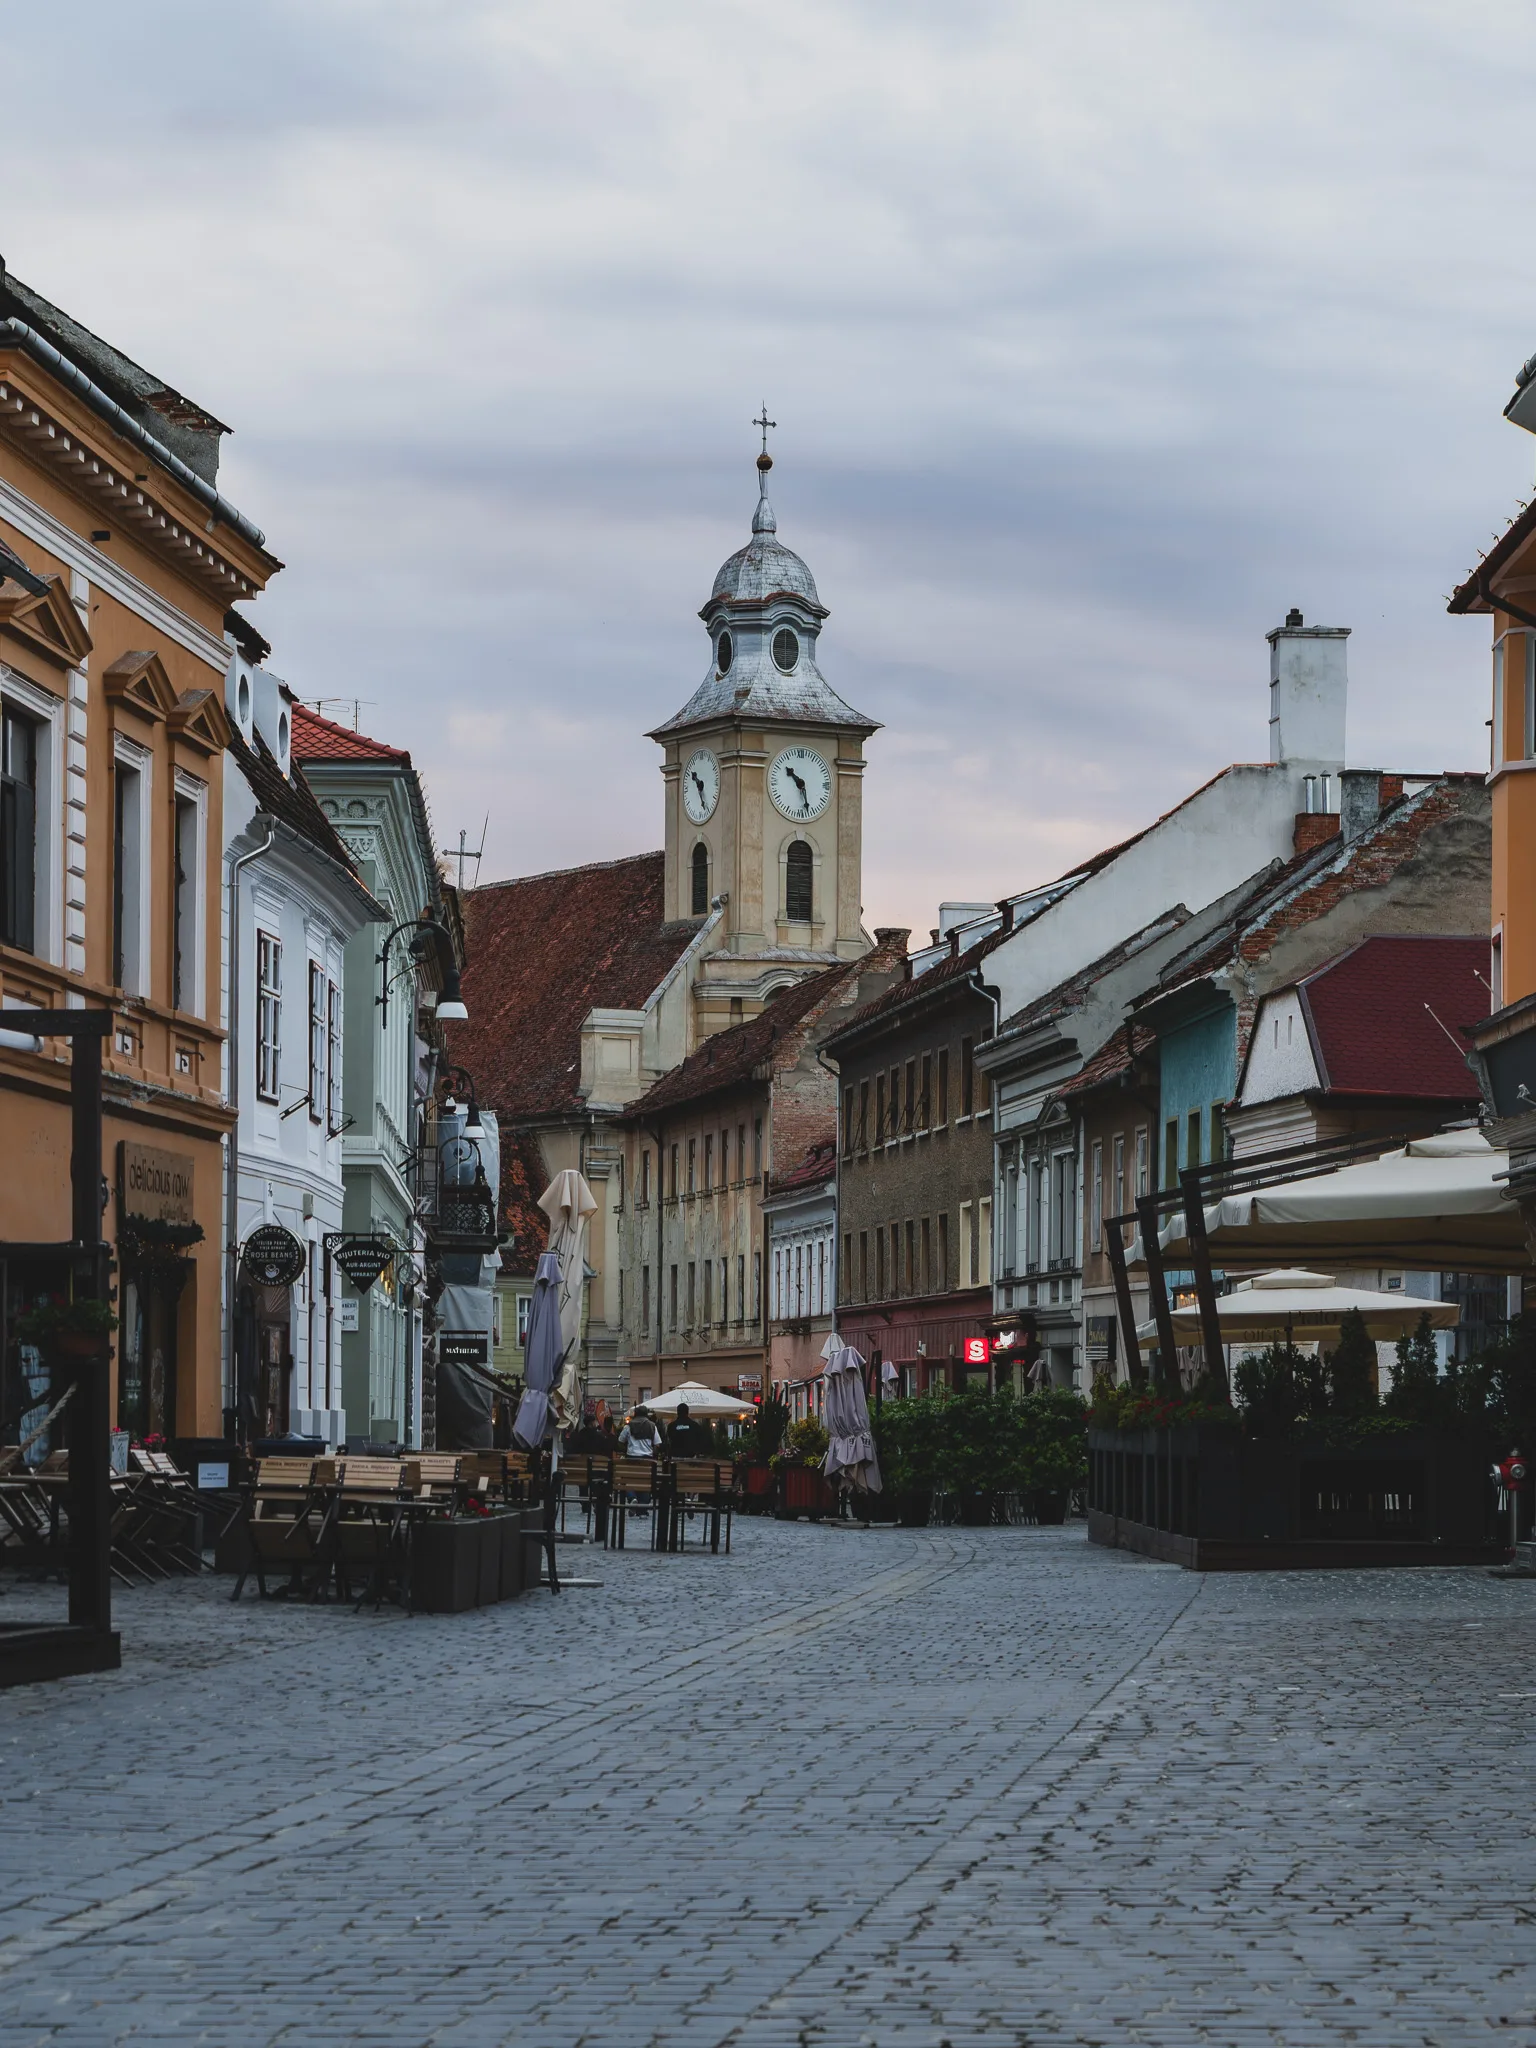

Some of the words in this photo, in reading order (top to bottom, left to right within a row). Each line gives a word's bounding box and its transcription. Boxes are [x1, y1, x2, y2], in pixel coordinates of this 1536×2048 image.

[129, 1156, 171, 1196] delicious
[172, 1173, 190, 1199] raw
[250, 1251, 269, 1259] ROSE
[270, 1251, 293, 1259] BEANS
[337, 1249, 375, 1260] BIJUTERIA
[376, 1250, 391, 1260] VIO
[445, 1346, 480, 1354] MATHILDE
[969, 1340, 985, 1357] S
